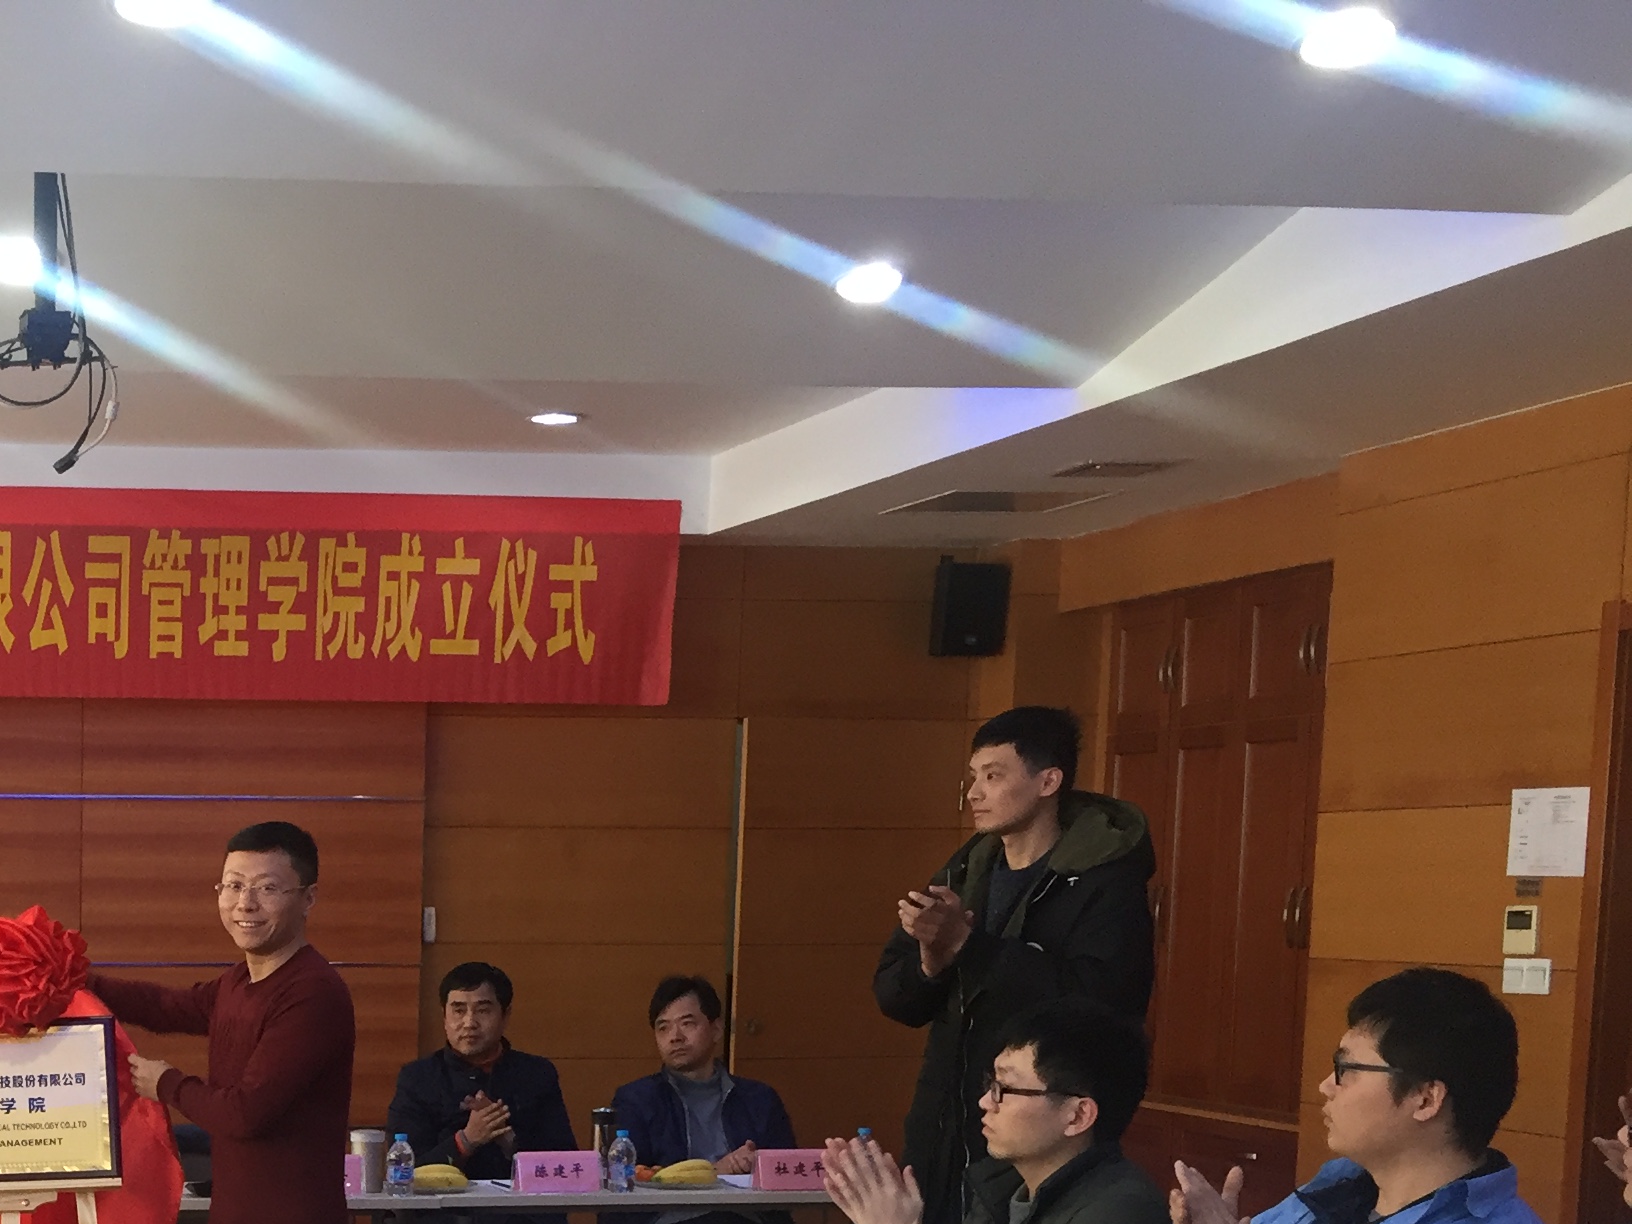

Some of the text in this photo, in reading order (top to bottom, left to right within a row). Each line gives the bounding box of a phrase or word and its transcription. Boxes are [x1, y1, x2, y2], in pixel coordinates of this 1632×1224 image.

[12, 1122, 59, 1131] TECHNOLOGY
[534, 1162, 584, 1179] 陈建平
